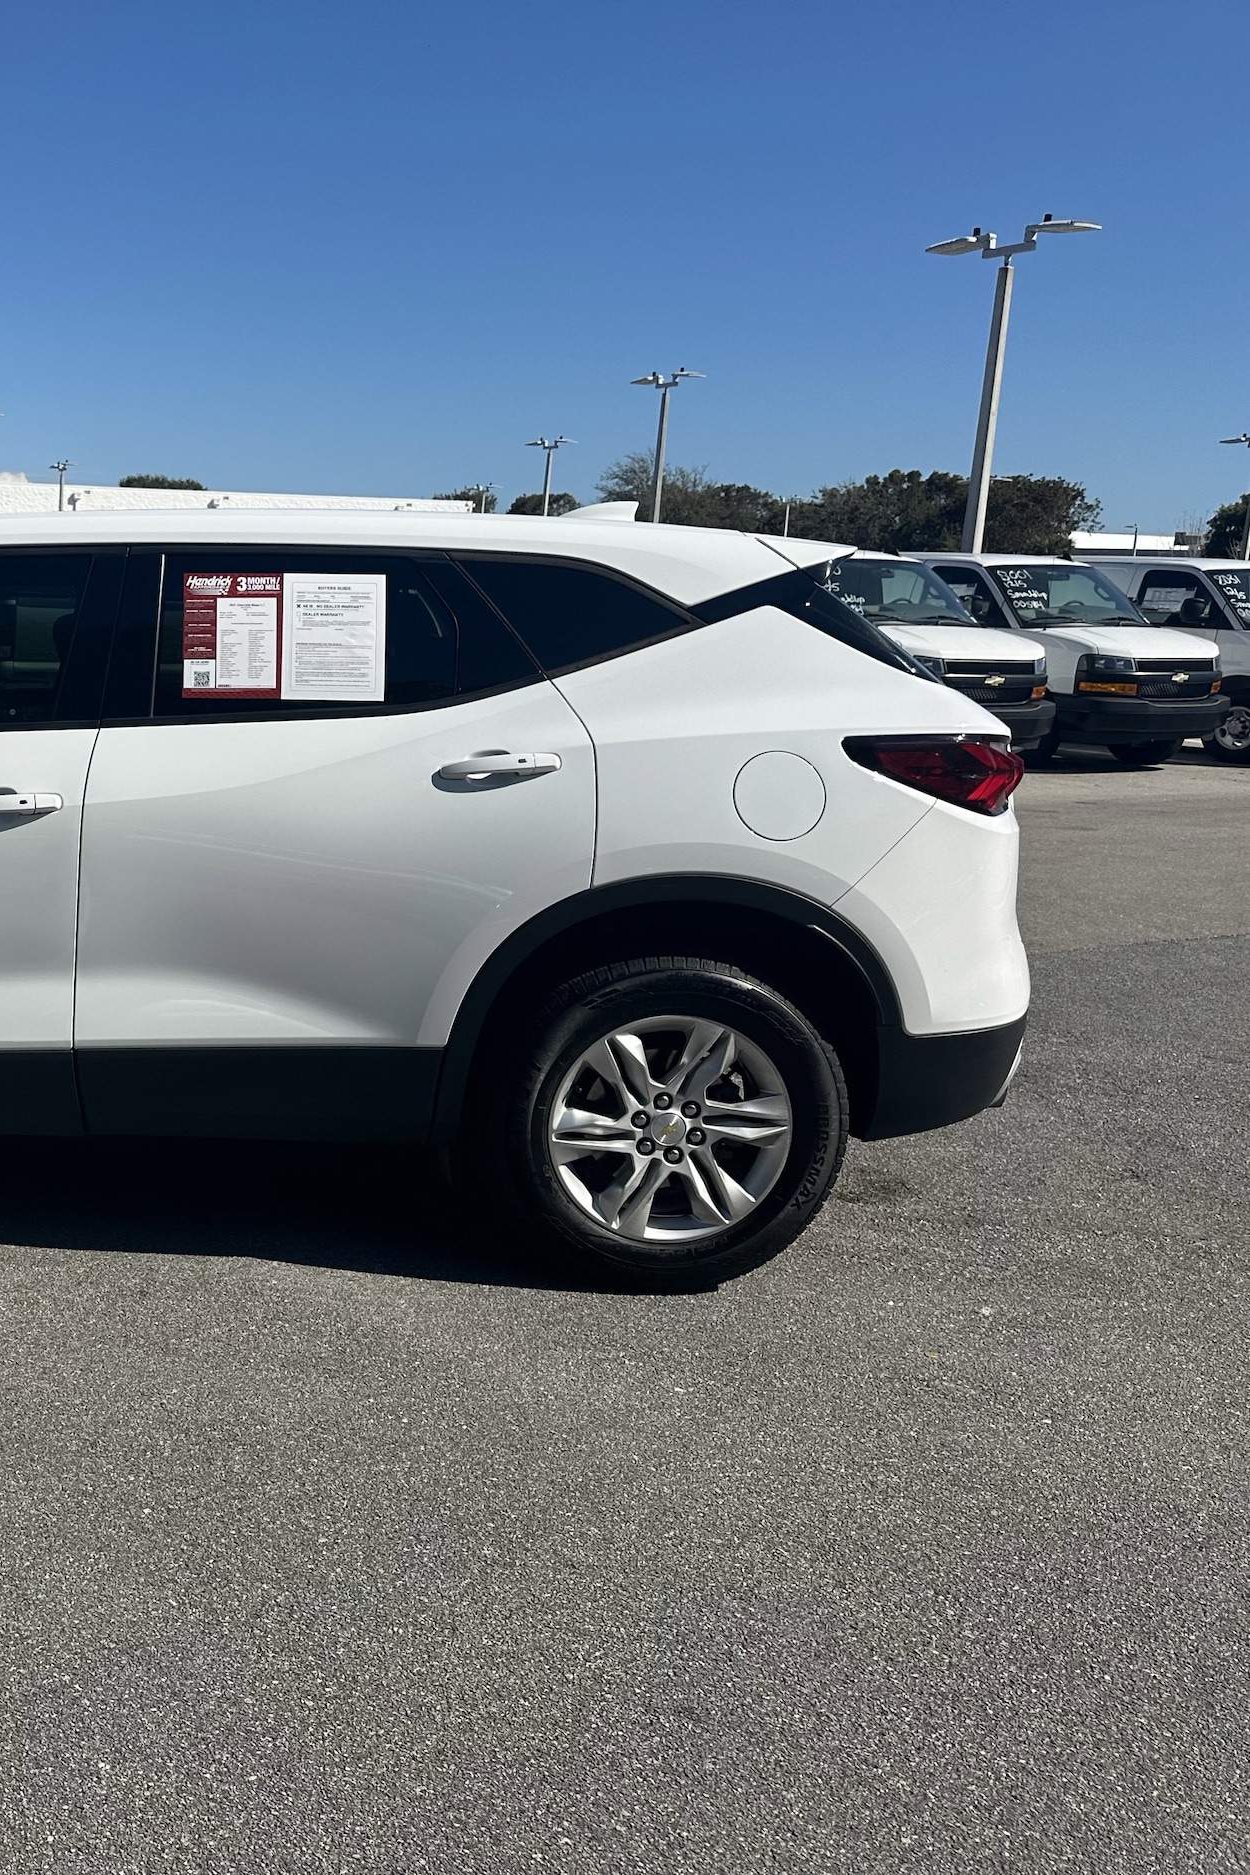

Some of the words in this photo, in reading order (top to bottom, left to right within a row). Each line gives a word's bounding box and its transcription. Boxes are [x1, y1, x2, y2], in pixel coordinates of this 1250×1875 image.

[996, 569, 1033, 581] 8001
[186, 576, 233, 589] Hendrick
[237, 576, 247, 591] 3
[247, 577, 280, 585] MONTH/
